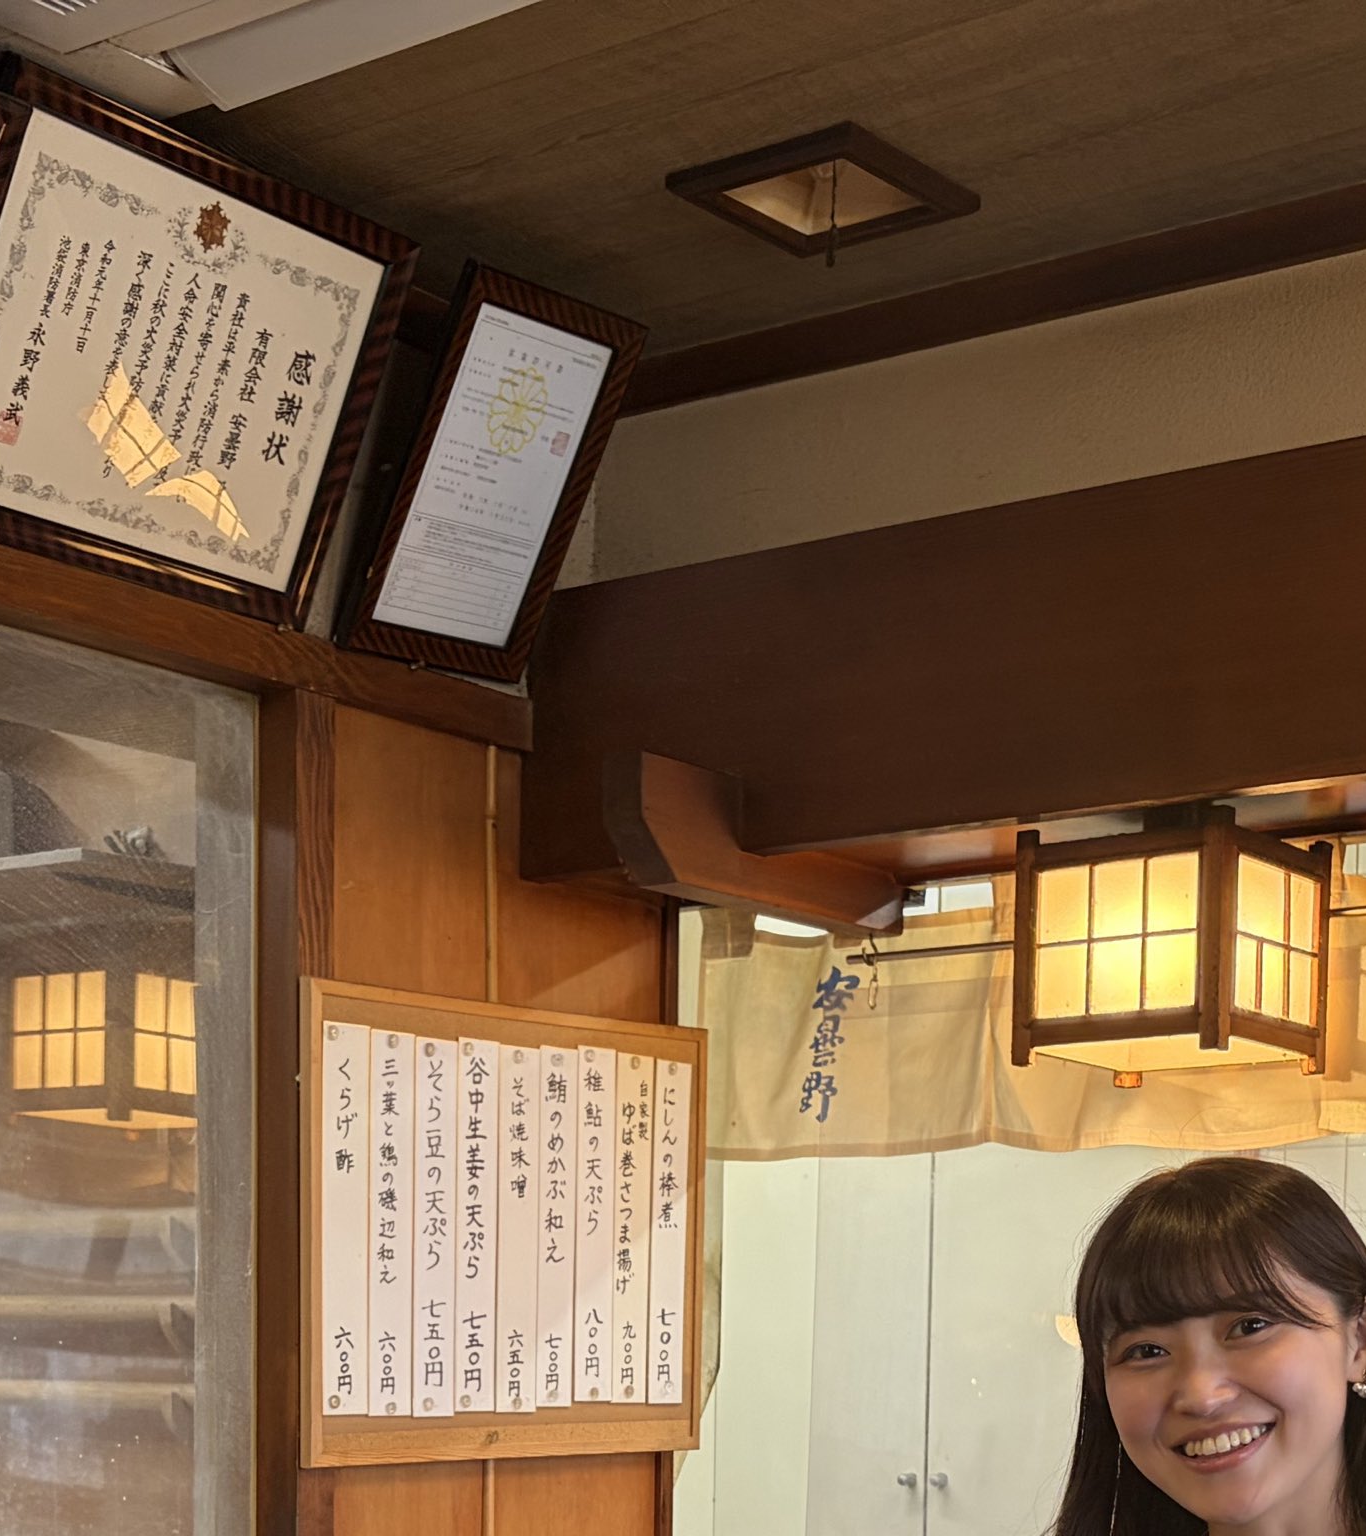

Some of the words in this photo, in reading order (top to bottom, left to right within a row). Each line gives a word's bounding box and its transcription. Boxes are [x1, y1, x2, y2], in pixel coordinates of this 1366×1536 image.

[60, 241, 91, 317] 東京消防庁
[237, 327, 274, 405] 有限会社
[261, 349, 317, 467] 感謝状
[638, 1080, 649, 1140] 自家製
[799, 966, 860, 1123] 安曇野
[335, 1058, 357, 1173] くらげ酢
[423, 1060, 447, 1270] そら豆の天ぷら
[463, 1057, 490, 1279] 谷中生姜の天ぷら
[509, 1077, 530, 1198] そば焼味噌
[545, 1072, 567, 1263] 鮪のめかぶ和え
[584, 1070, 604, 1236] 稚鮎の天ぷら
[658, 1088, 678, 1228] にしんの棒煮
[614, 1100, 636, 1295] ゆば巻さつま揚げ
